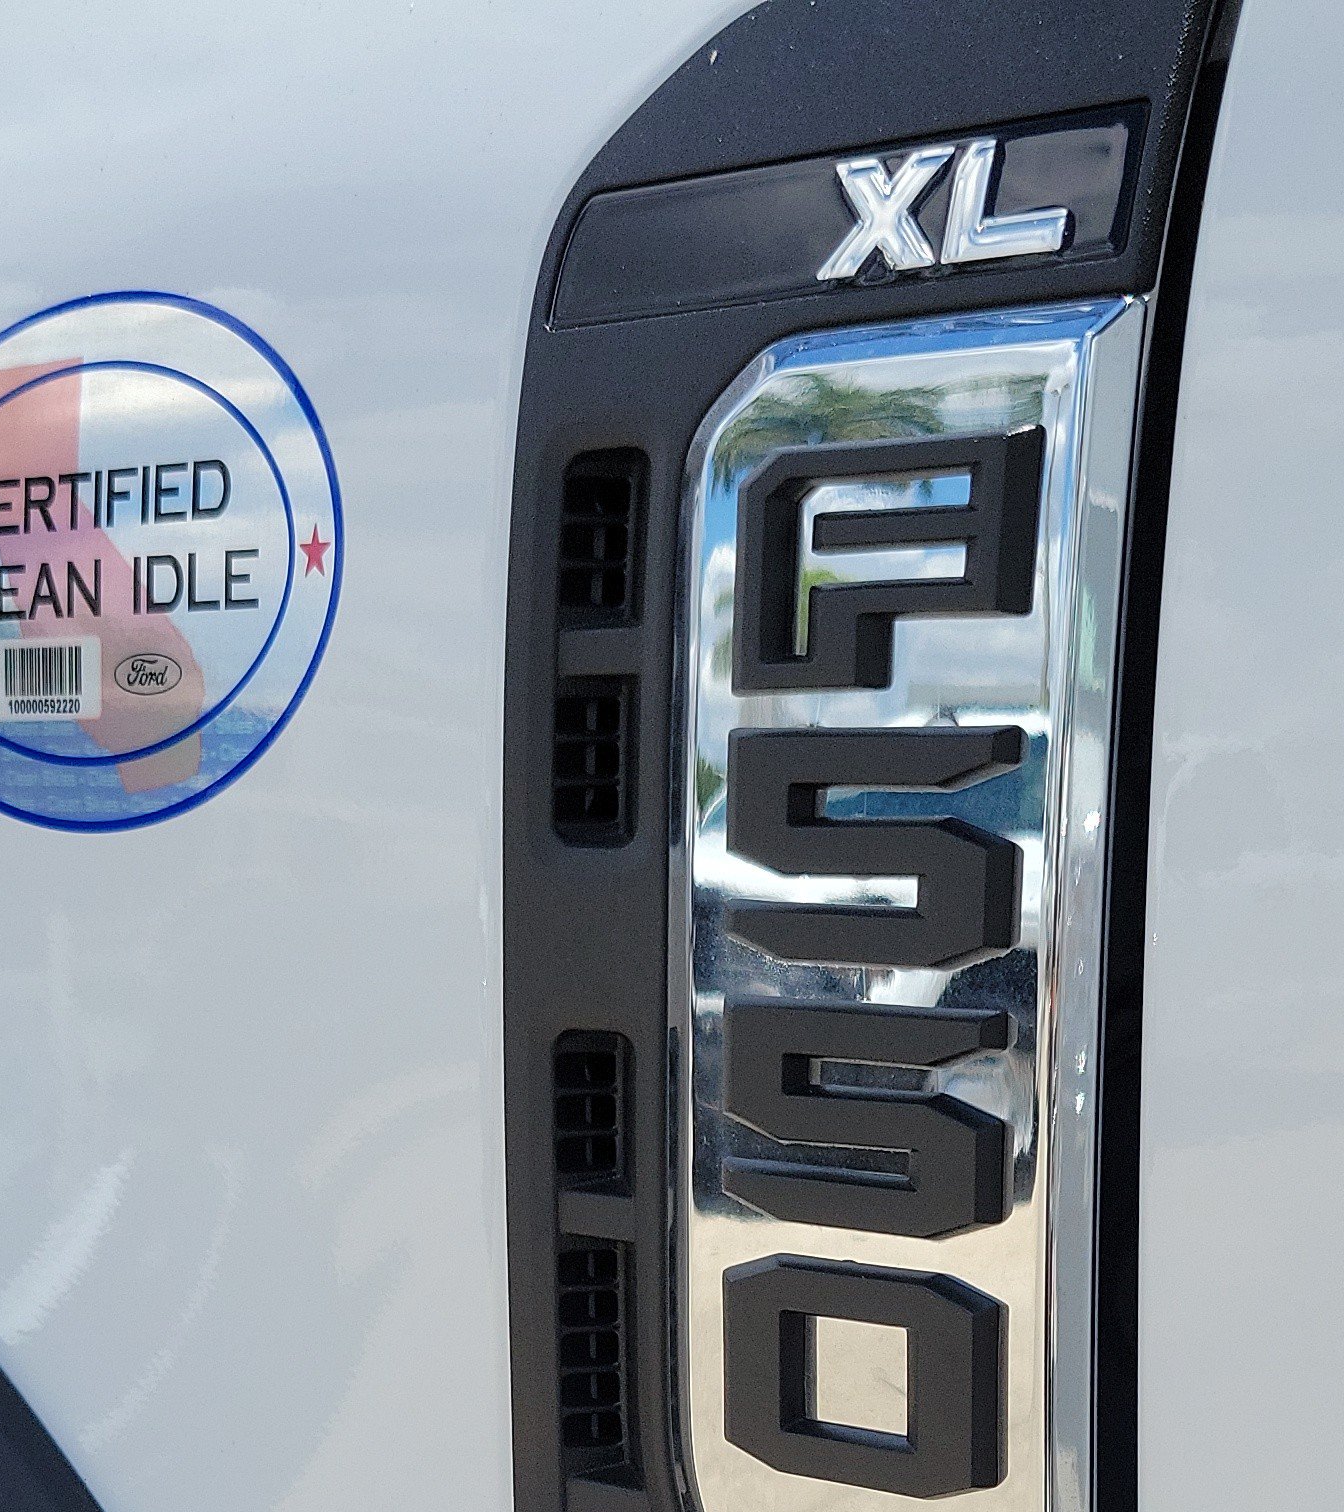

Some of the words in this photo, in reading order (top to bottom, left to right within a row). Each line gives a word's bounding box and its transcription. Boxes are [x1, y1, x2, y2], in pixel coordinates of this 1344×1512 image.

[816, 137, 1068, 281] XL
[133, 549, 259, 615] IDLE
[127, 658, 169, 687] Ford
[8, 698, 81, 715] 100000592220
